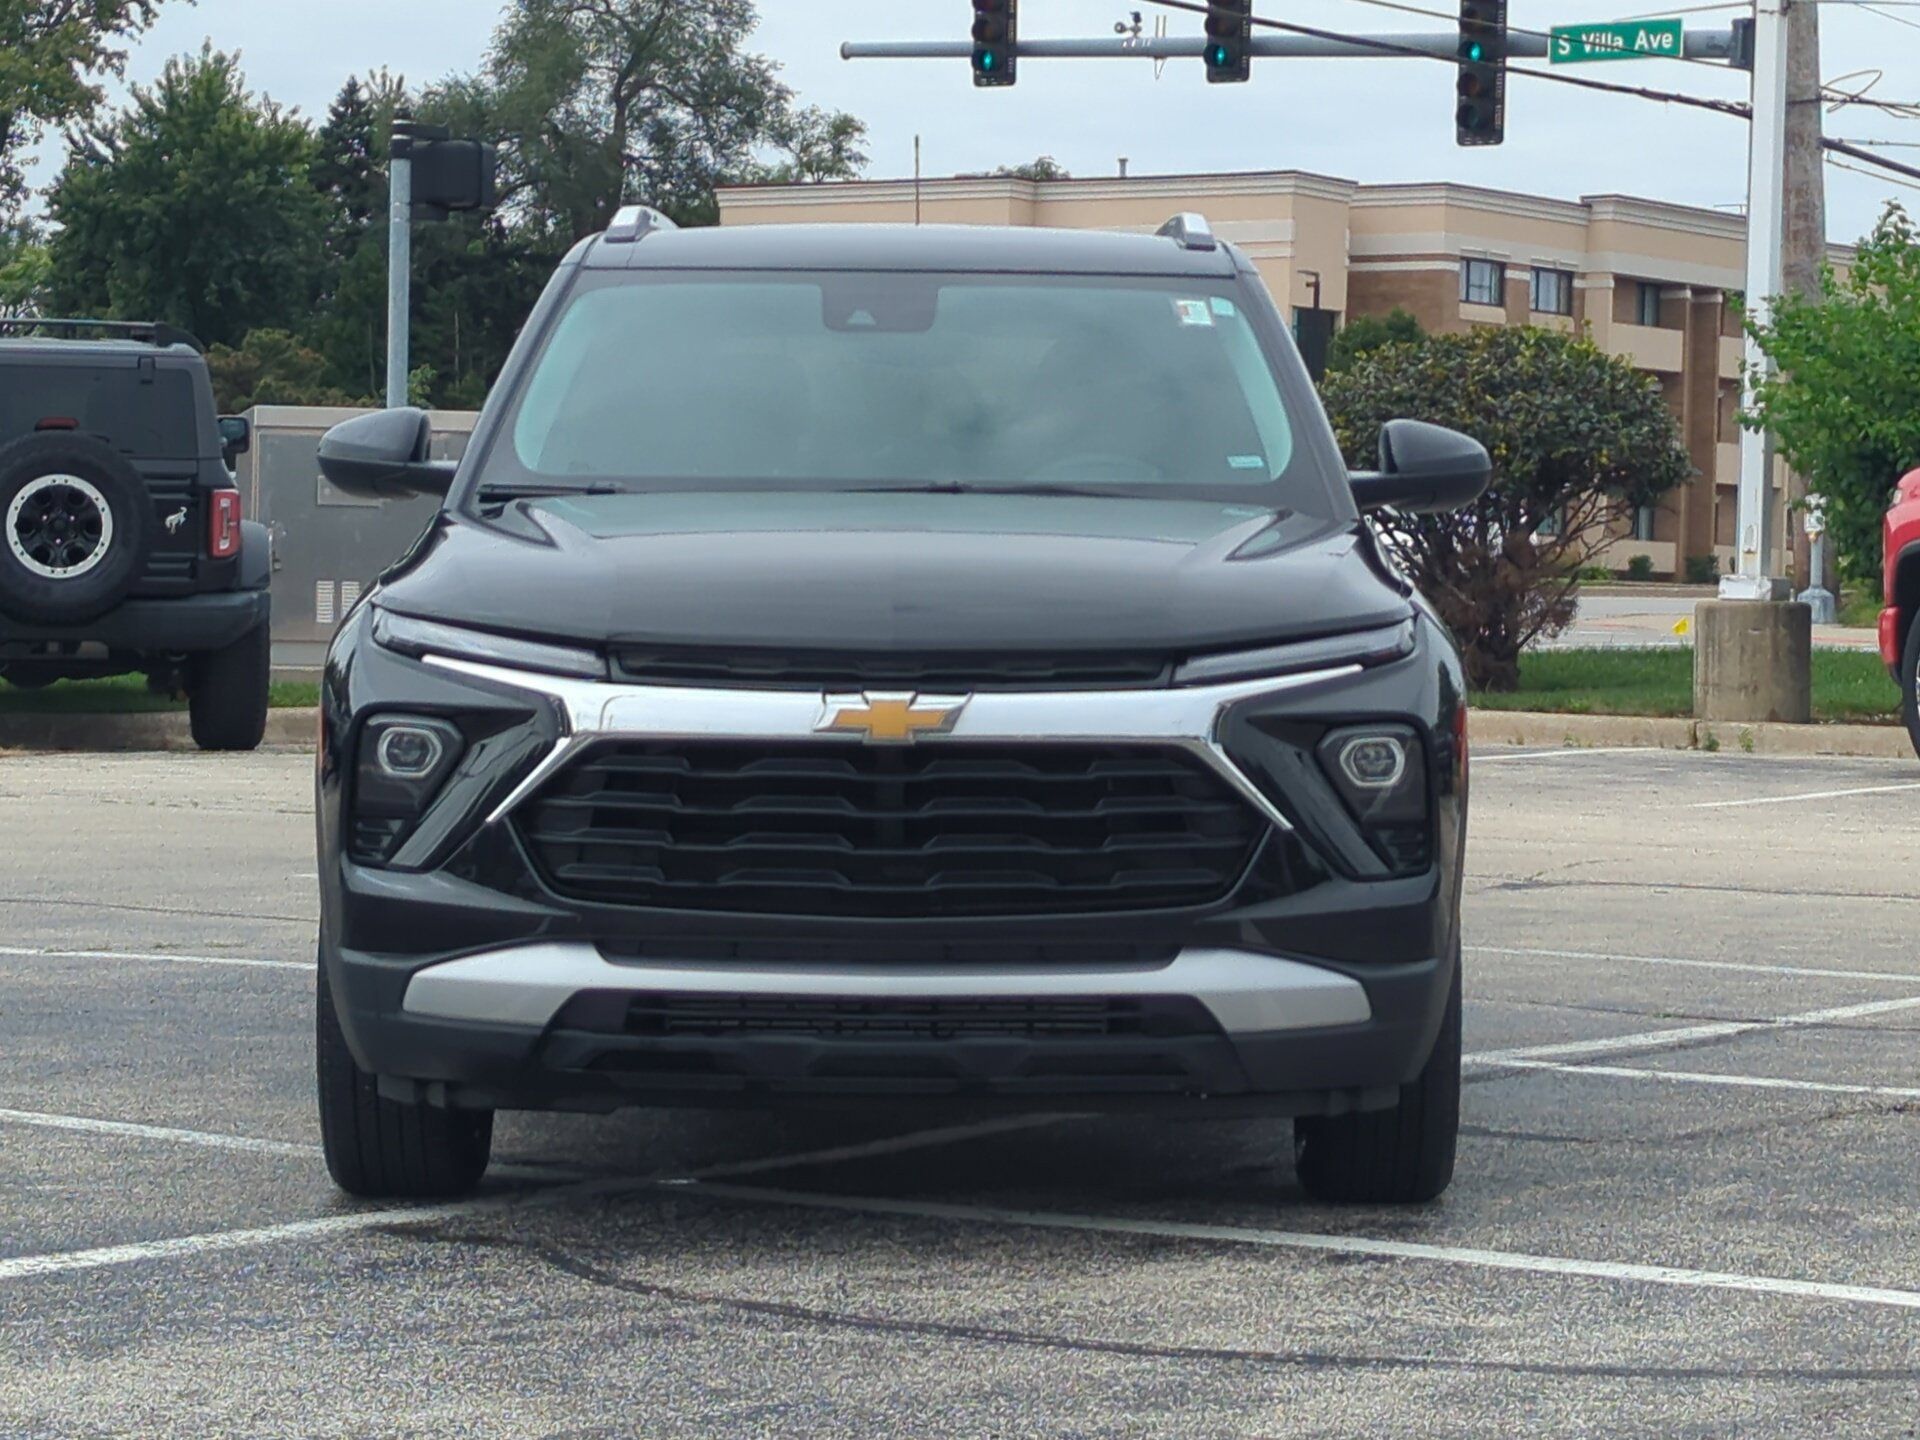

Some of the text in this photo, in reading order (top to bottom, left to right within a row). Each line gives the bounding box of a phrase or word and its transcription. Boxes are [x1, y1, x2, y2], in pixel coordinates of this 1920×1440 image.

[1558, 29, 1673, 55] S Villa Ave
